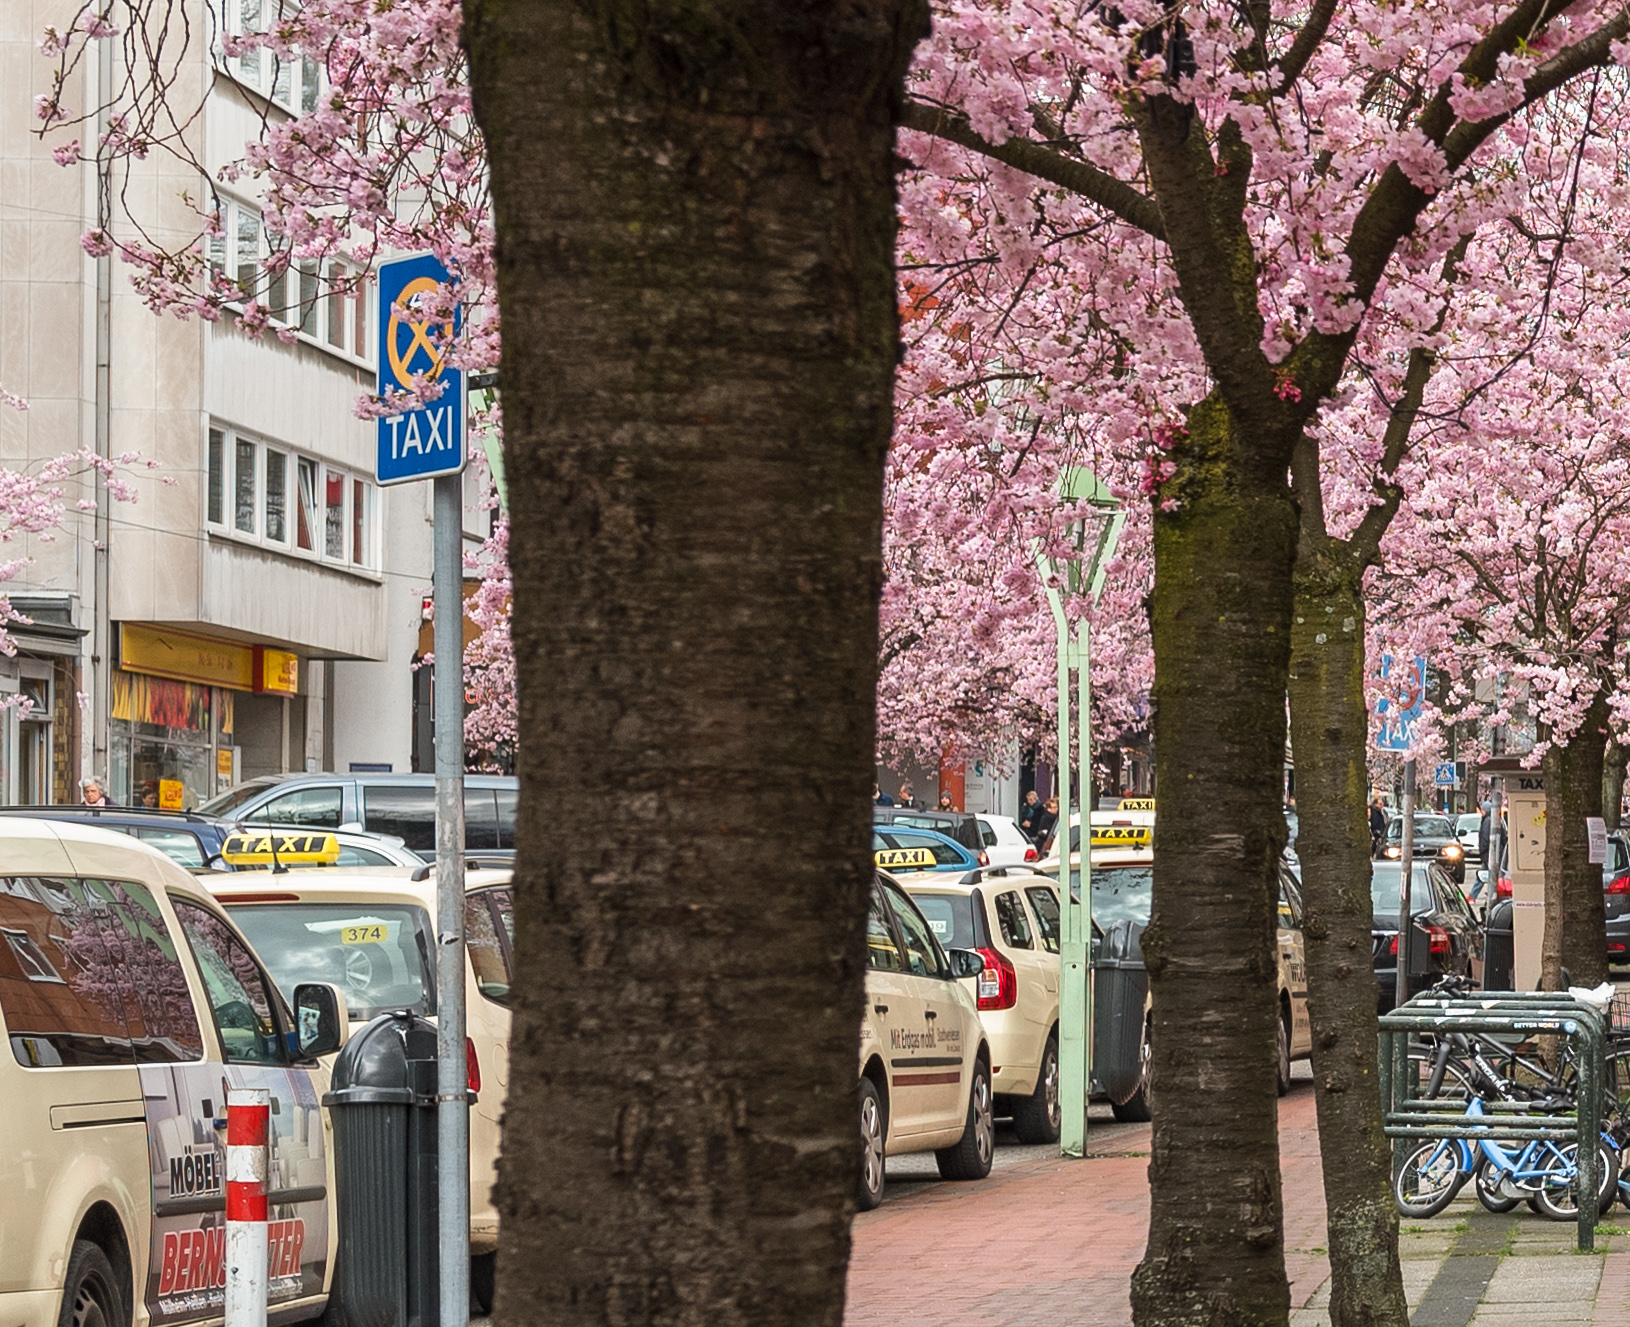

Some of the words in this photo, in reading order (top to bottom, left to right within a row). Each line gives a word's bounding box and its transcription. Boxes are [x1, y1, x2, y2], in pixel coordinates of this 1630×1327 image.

[386, 405, 453, 459] TAXI
[1519, 778, 1545, 790] TAX
[1124, 801, 1152, 810] TAXI
[1095, 829, 1145, 838] TAXI
[239, 837, 314, 852] TAXI
[881, 850, 925, 864] TAXI
[348, 927, 381, 941] 374
[170, 1145, 221, 1197] MÖBEL
